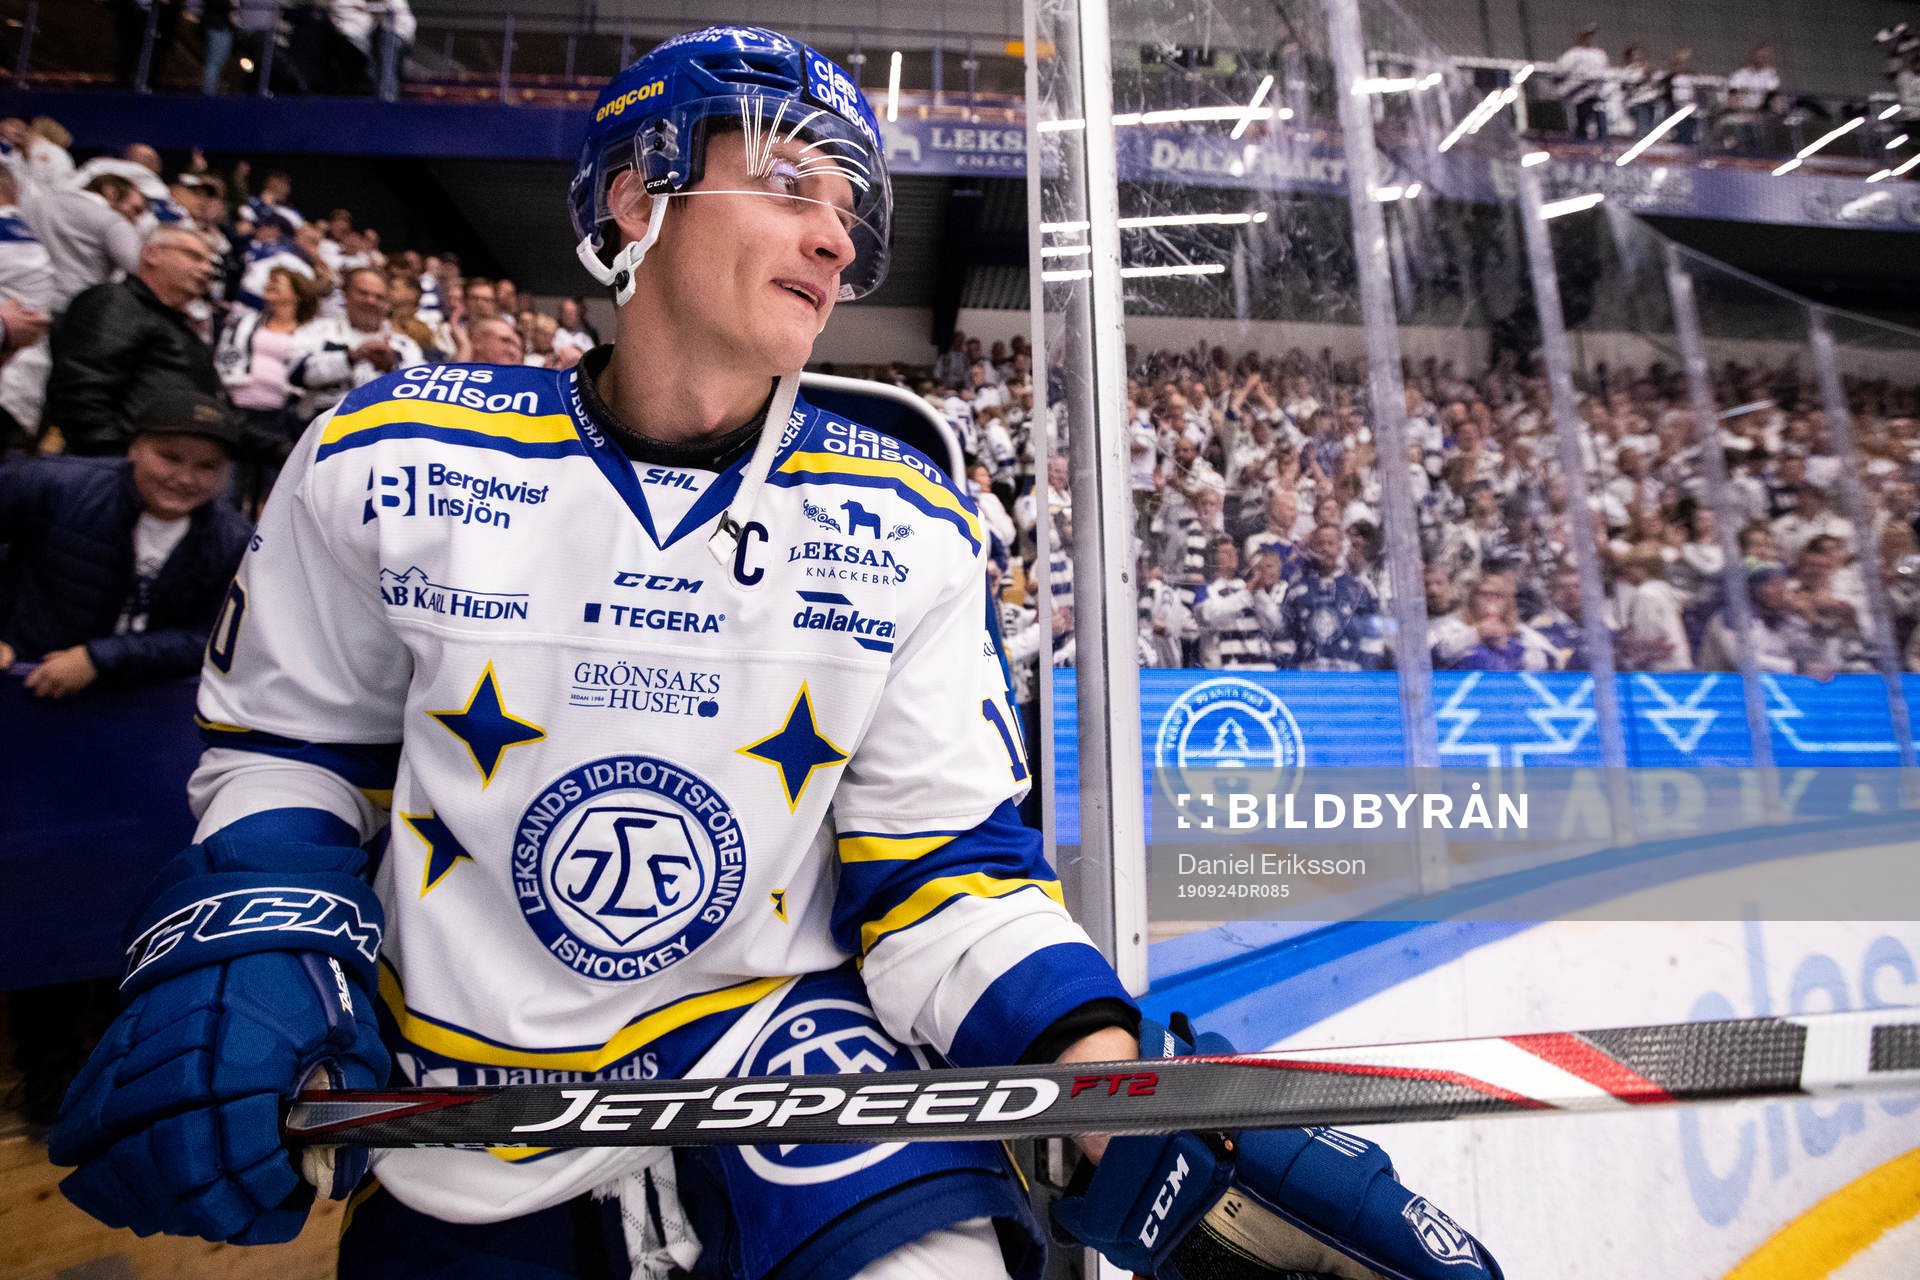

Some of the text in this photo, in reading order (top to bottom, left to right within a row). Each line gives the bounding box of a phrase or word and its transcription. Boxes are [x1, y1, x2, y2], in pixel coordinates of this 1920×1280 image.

[596, 81, 664, 122] engcon
[814, 60, 857, 103] clas
[817, 84, 878, 147] ohlson
[930, 127, 1025, 151] LEKS
[646, 178, 669, 189] CCM
[403, 365, 494, 384] clas
[392, 381, 538, 414] ohlson
[825, 420, 900, 451] clas
[643, 468, 699, 492] SHL
[822, 437, 943, 484] ohlson
[427, 463, 549, 505] Bergkvist
[428, 494, 511, 529] Insjön
[733, 520, 769, 586] C
[613, 571, 704, 594] CCM
[450, 593, 529, 620] HEDIN
[574, 660, 721, 694] GRÖNSAKS
[607, 688, 700, 716] HUSET
[982, 698, 1028, 782] 1
[514, 779, 583, 915] LEKSANDS
[583, 760, 743, 925] IDROTTSFÖRENING
[549, 933, 691, 979] ISHOCKEY
[511, 1072, 1159, 1133] JETSPEED FT2
[1137, 1152, 1191, 1249] CCM
